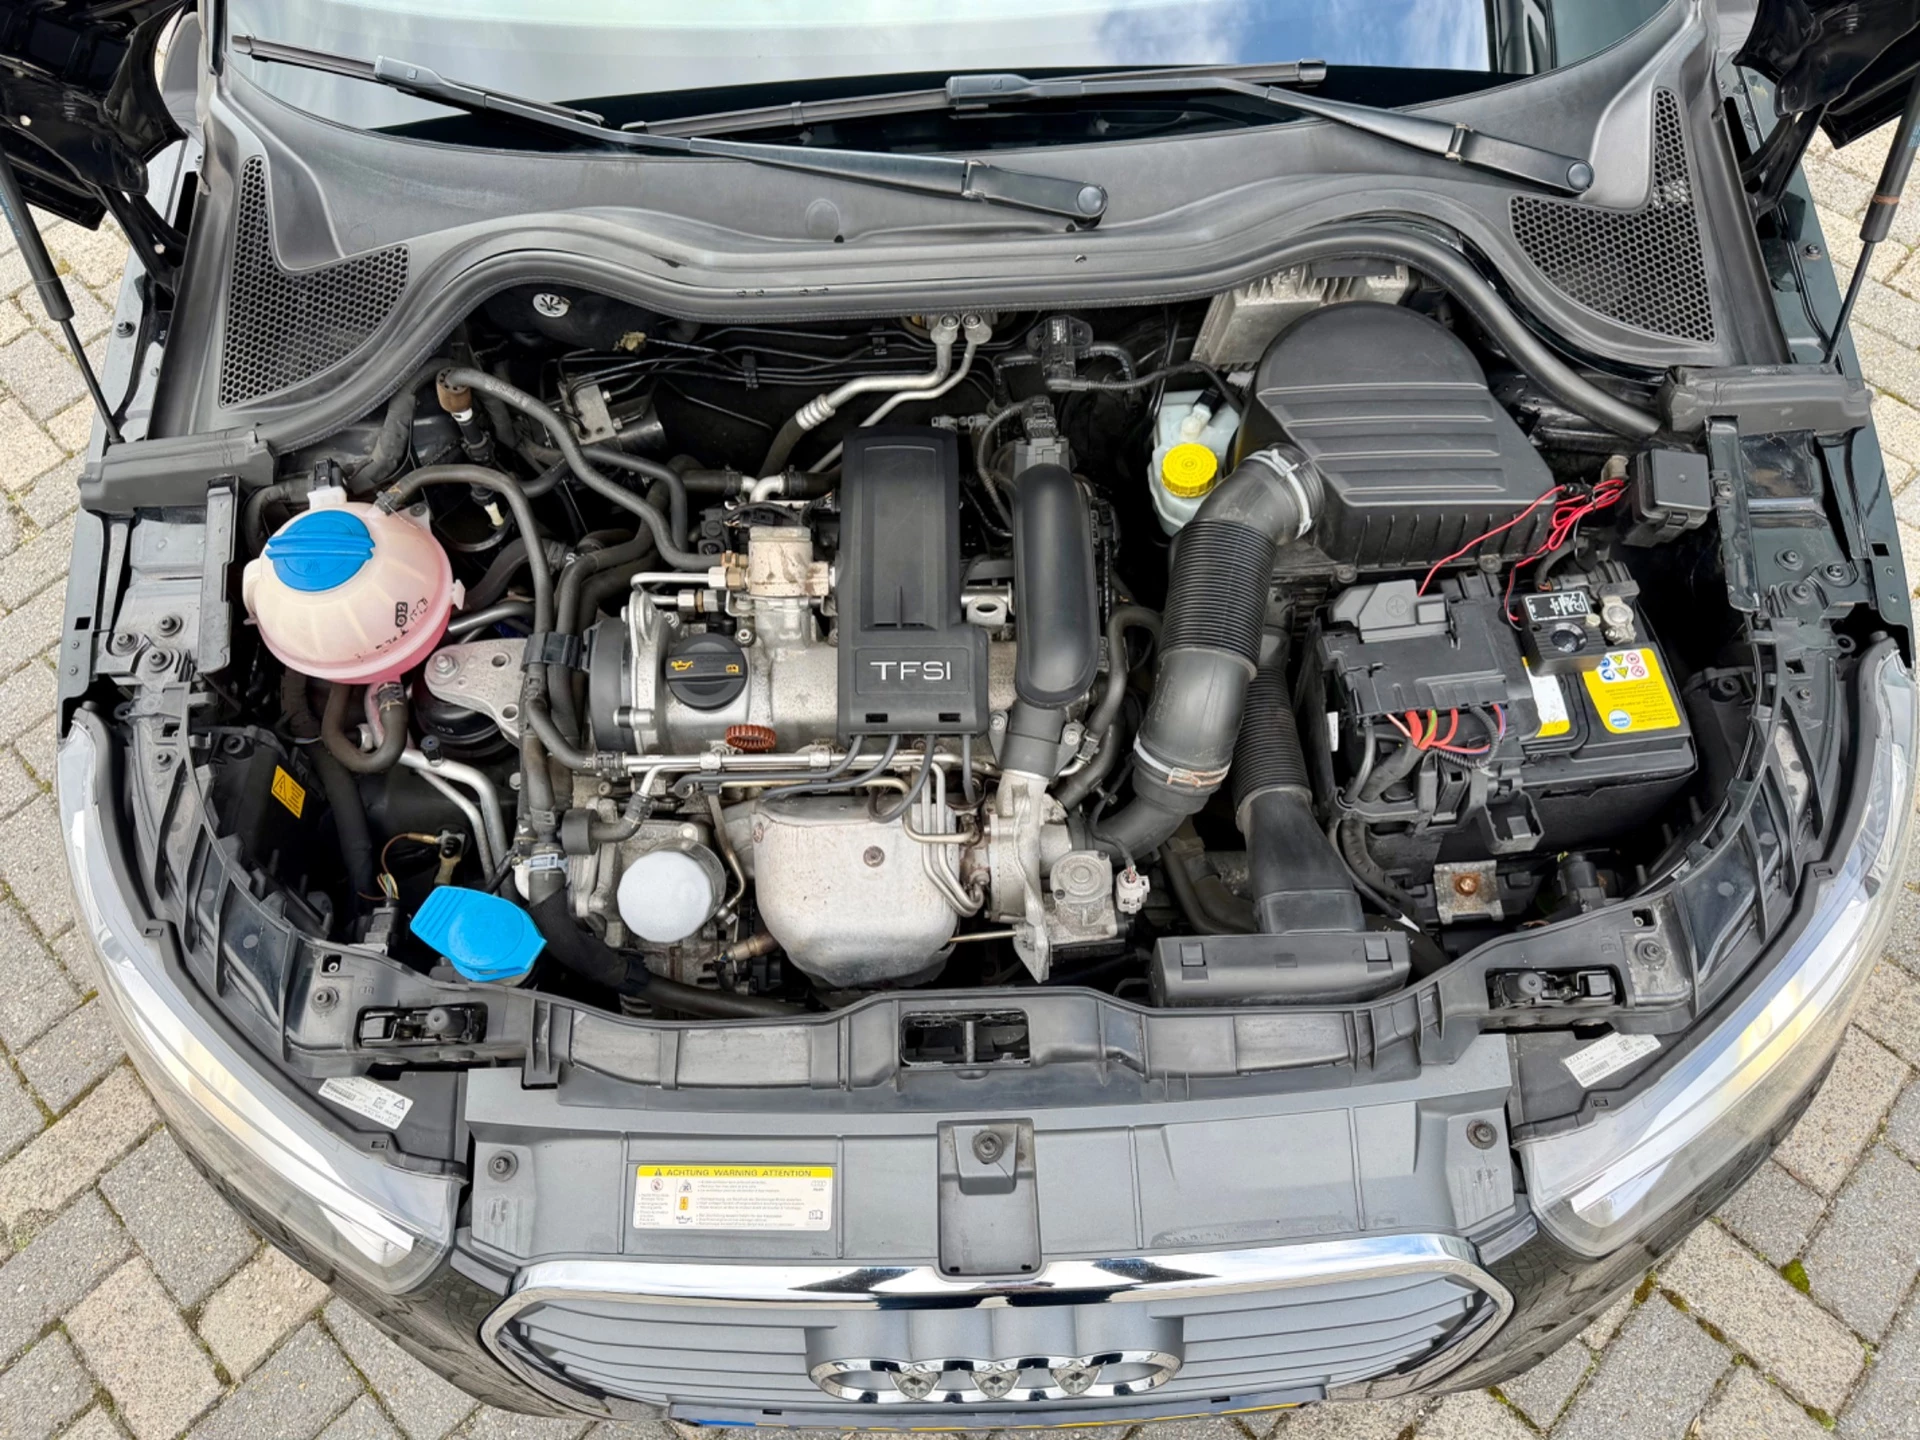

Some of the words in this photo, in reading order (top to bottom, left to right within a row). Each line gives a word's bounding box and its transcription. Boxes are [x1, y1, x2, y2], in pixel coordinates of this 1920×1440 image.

[870, 661, 951, 680] TFSI
[666, 1169, 709, 1177] ACHTUNG
[713, 1169, 758, 1177] WARNING
[761, 1169, 812, 1177] ATTENTION
